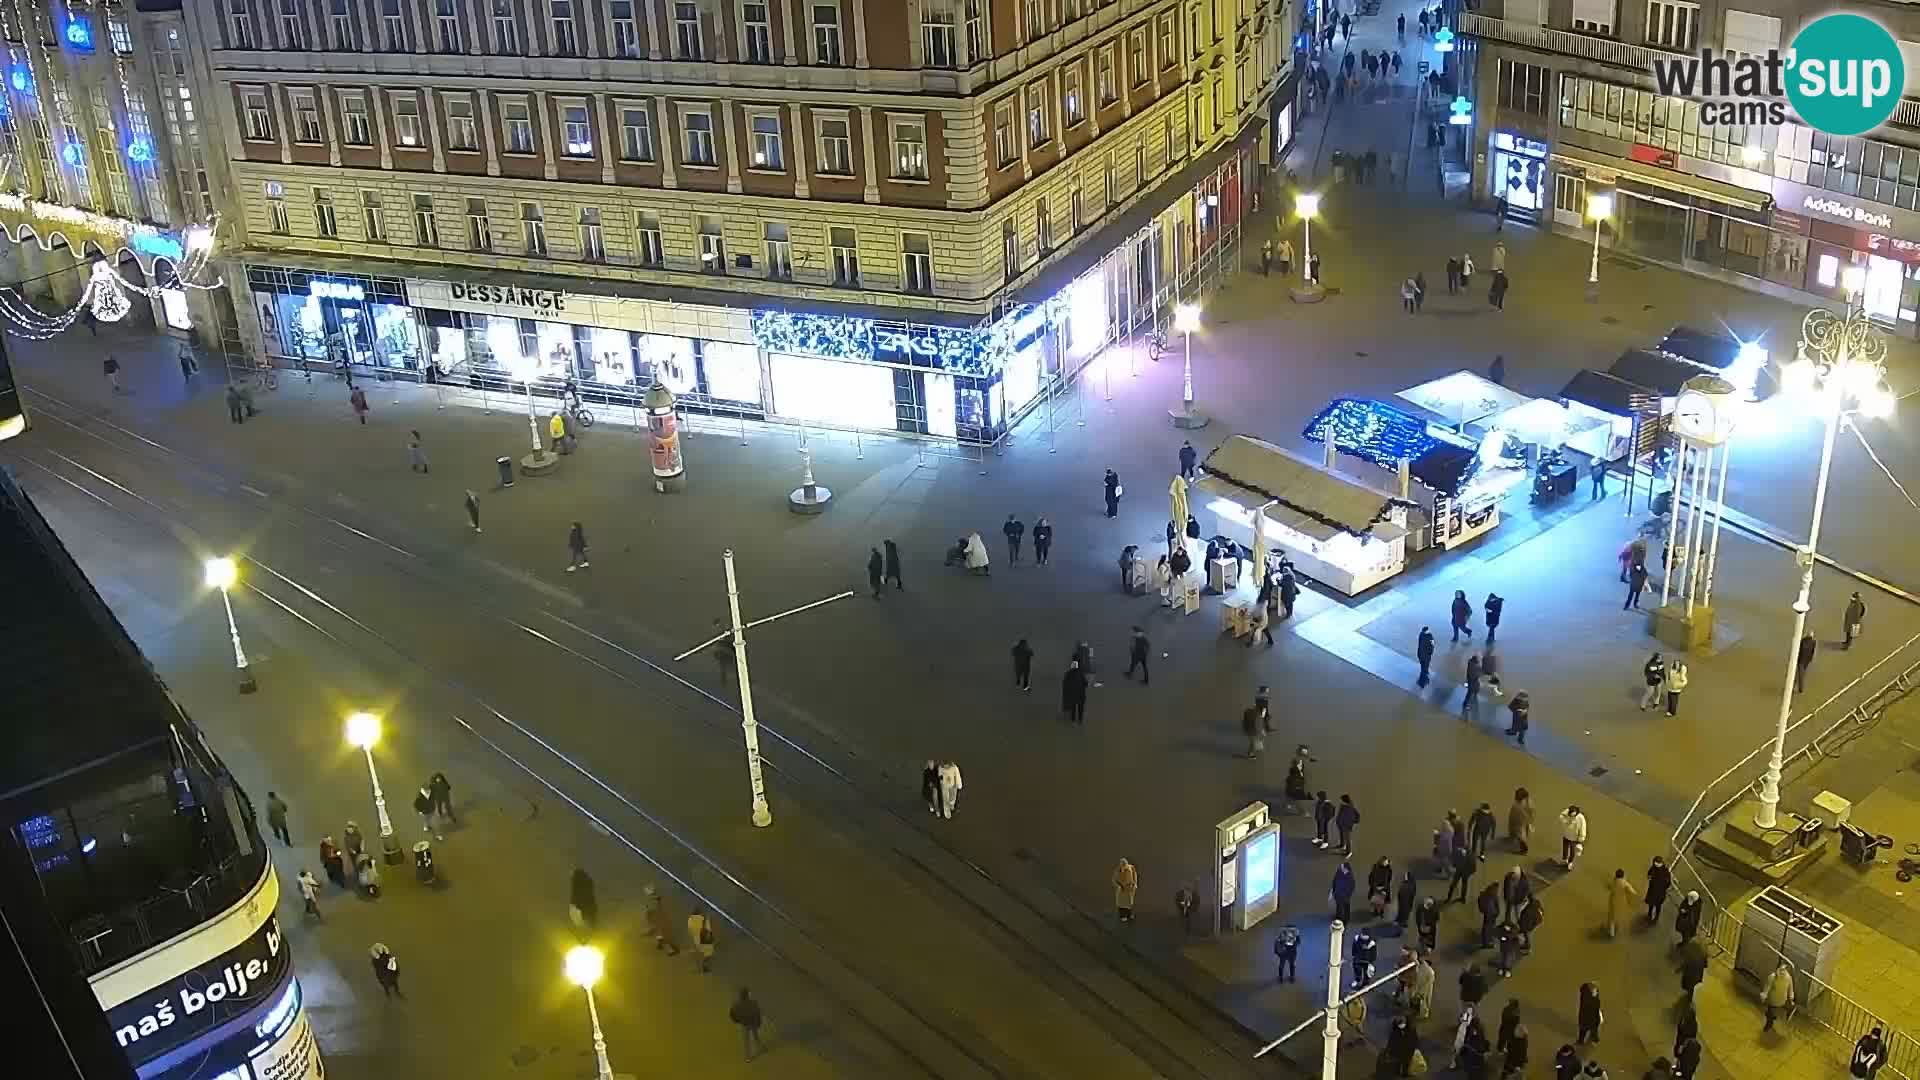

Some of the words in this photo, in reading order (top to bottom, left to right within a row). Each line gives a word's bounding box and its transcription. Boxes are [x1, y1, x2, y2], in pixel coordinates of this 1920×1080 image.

[1803, 196, 1853, 220] Addiko
[1854, 207, 1893, 229] Bank
[452, 282, 568, 311] DESSANGE
[115, 998, 176, 1047] naš
[179, 957, 269, 1015] bolje,
